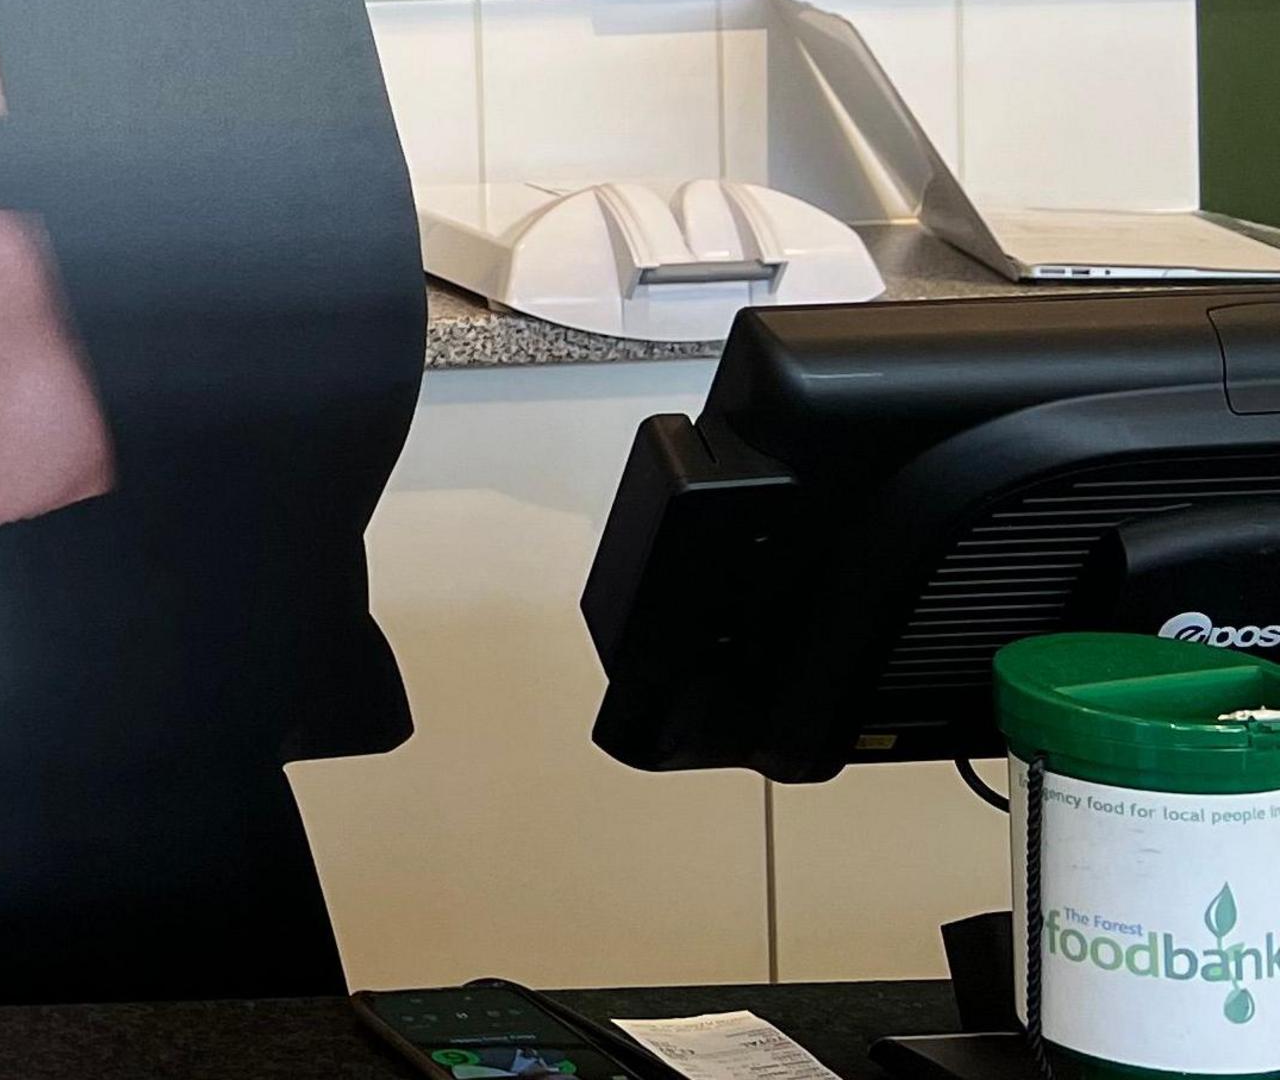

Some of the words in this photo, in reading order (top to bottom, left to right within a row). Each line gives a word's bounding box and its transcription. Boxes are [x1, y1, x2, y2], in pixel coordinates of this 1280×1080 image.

[1086, 796, 1125, 816] food
[1130, 802, 1156, 820] for
[1163, 806, 1205, 823] local
[1211, 806, 1266, 825] people
[1063, 907, 1090, 927] The
[1093, 915, 1144, 938] Forest
[1041, 909, 1280, 984] foodbank
